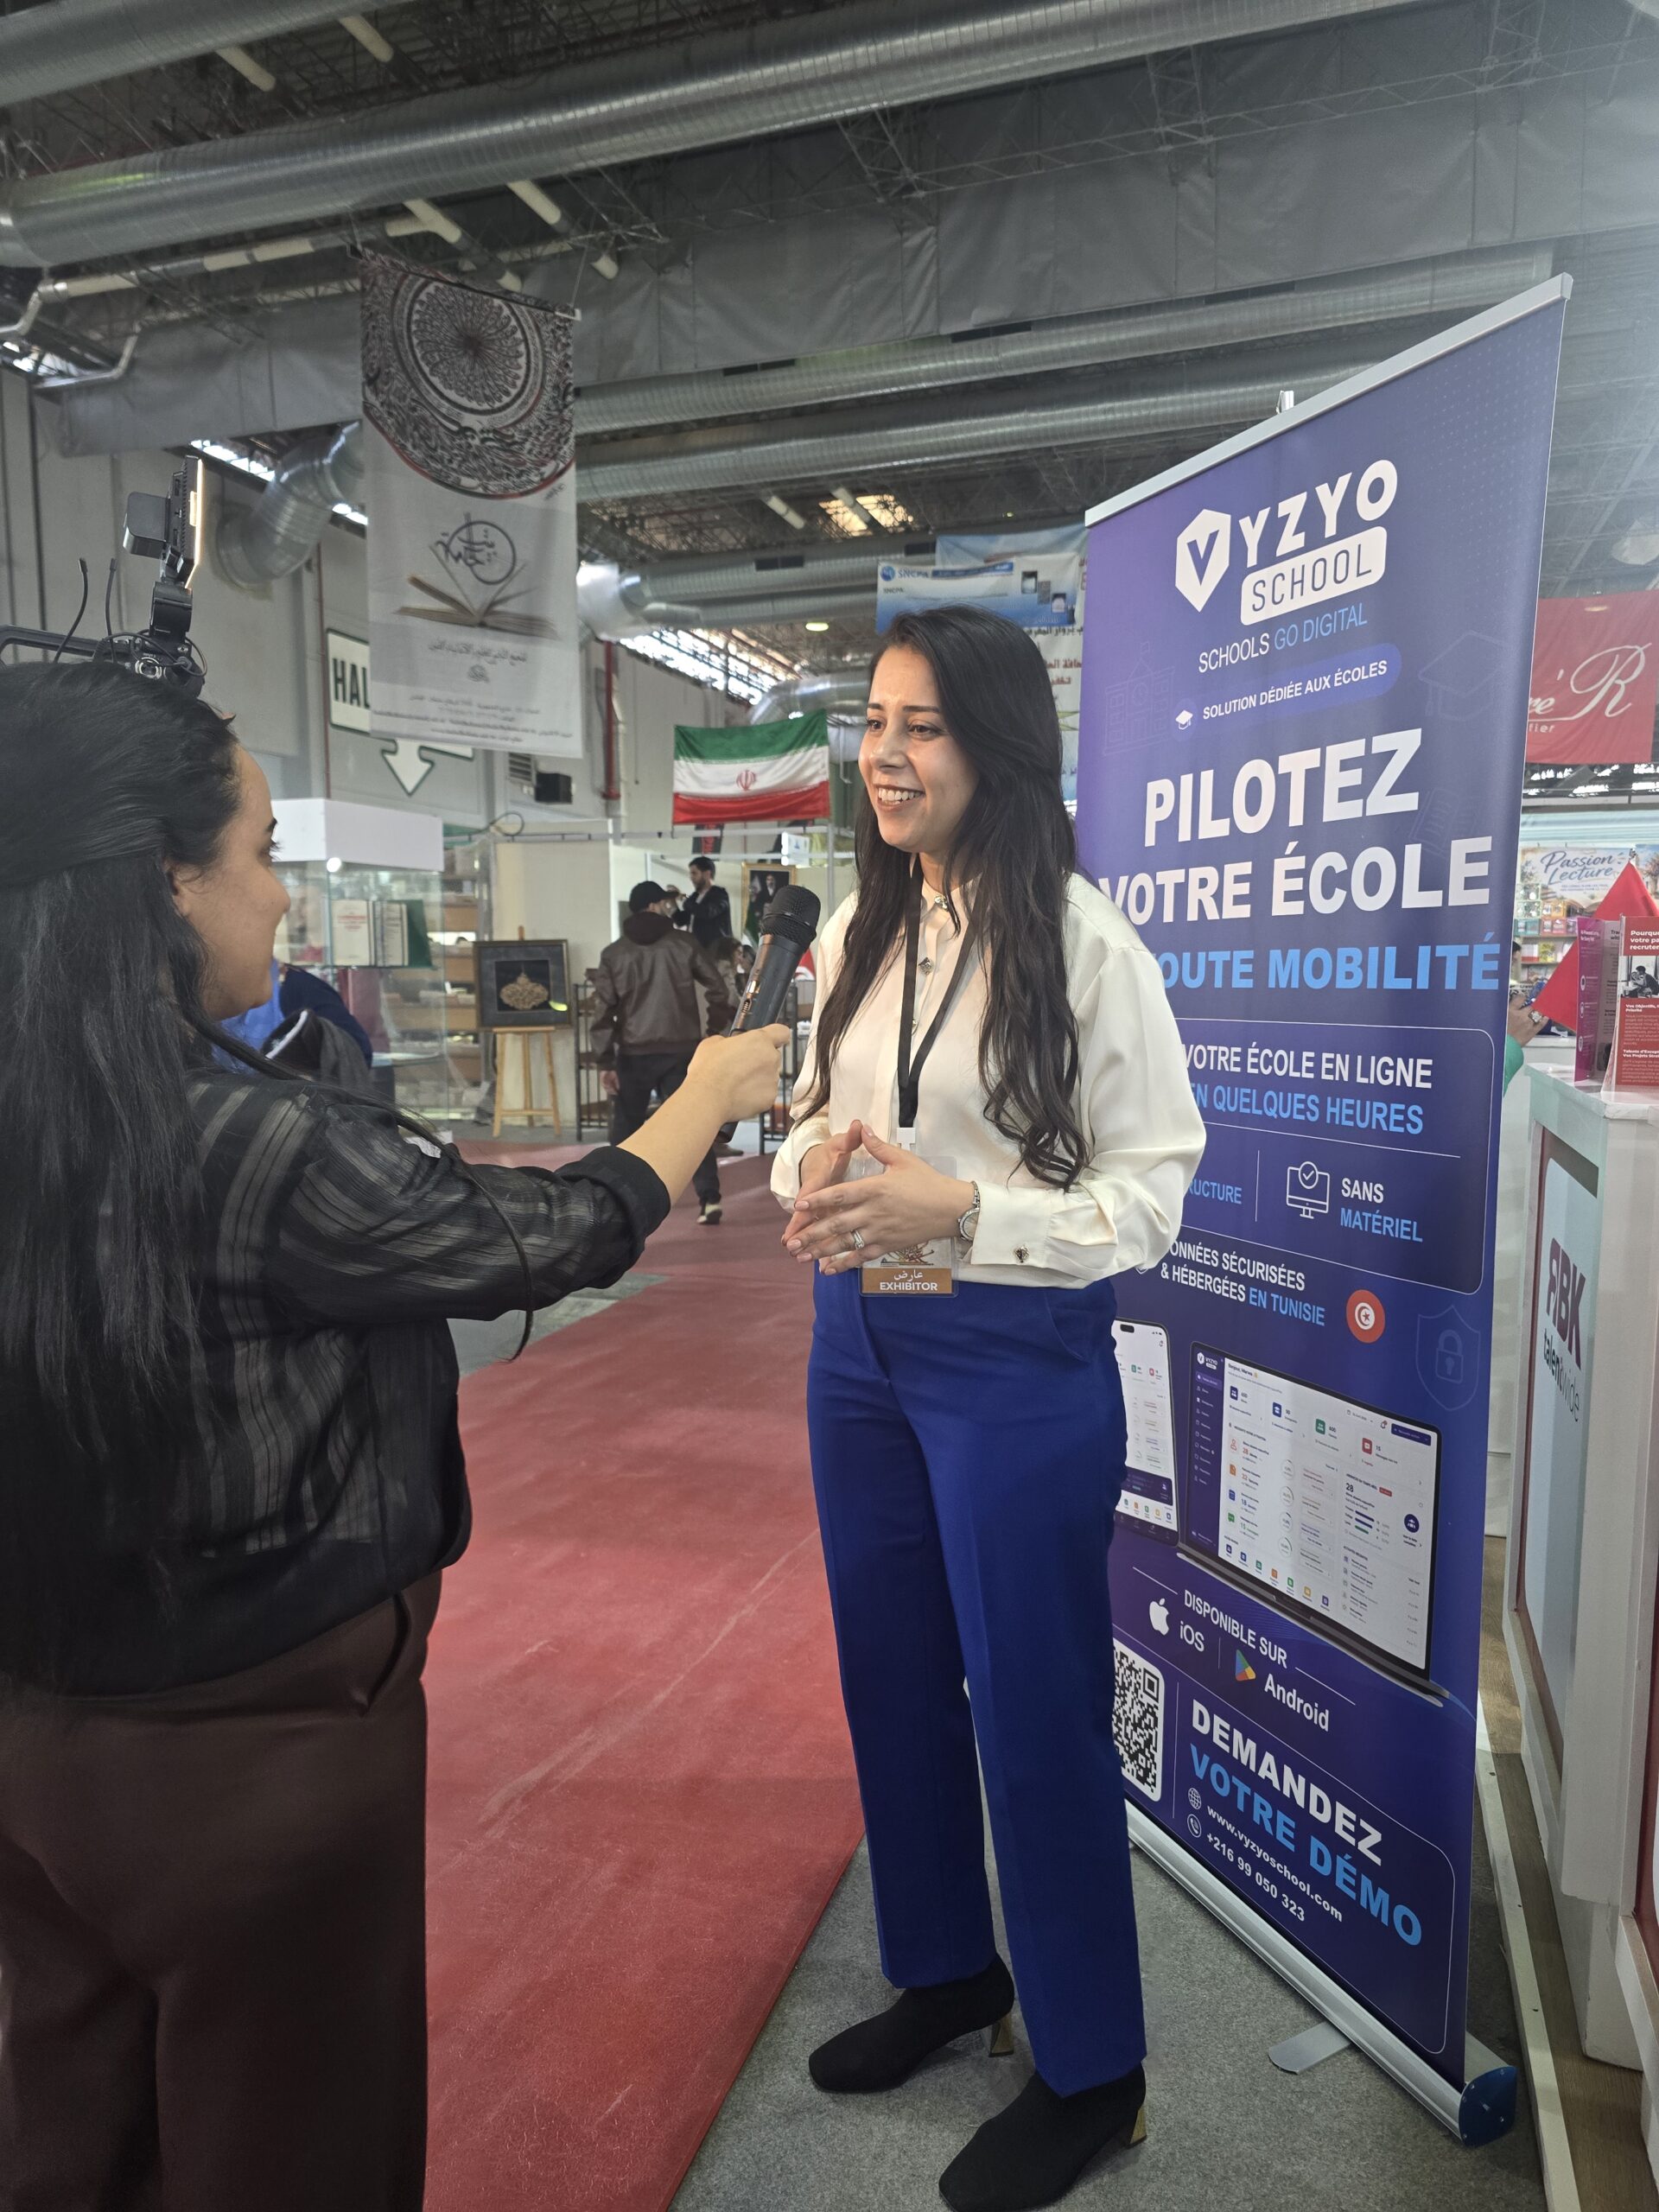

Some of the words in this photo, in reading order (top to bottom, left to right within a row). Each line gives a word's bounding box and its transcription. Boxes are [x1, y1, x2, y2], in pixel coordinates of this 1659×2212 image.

[1252, 543, 1372, 612] SCHOOL
[1198, 632, 1269, 673] SCHOOLS
[1274, 624, 1298, 651] GO
[1303, 602, 1368, 643] DIGITAL
[1203, 696, 1256, 721] SOLUTION
[1259, 680, 1302, 705] DÉDIÉE
[1305, 675, 1331, 694] AUX
[1334, 659, 1388, 687] ÉCOLES
[1144, 728, 1421, 847] PILOTEZ
[1098, 861, 1252, 925] VOTRE
[1271, 836, 1492, 917] ÉCOLE
[1541, 851, 1613, 873] Passion
[1548, 867, 1612, 885] Lecture
[1154, 950, 1253, 988] OUTE
[1268, 932, 1500, 990] MOBILITÉ
[1183, 1044, 1242, 1072] VOTRE
[1247, 1042, 1315, 1079] ÉCOLE
[1321, 1053, 1350, 1083] EN
[1357, 1056, 1433, 1089] LIGNE
[1213, 1085, 1320, 1123] QUELQUES
[1325, 1096, 1424, 1135] HEURES
[1341, 1178, 1384, 1205] SANS
[1340, 1208, 1423, 1243] MATÉRIEL
[880, 1281, 938, 1291] EXHIBITOR
[893, 1269, 924, 1282] عارض
[1160, 1262, 1169, 1280] &
[1172, 1262, 1246, 1303] HÉBERGÉES
[1249, 1288, 1268, 1309] EN
[1270, 1293, 1325, 1326] TUNISIE
[1169, 1239, 1219, 1267] ONNÉES
[1222, 1252, 1306, 1291] SÉCURISÉES
[1179, 1621, 1205, 1652] iOS
[1185, 1590, 1256, 1649] DISPONIBLE
[1259, 1637, 1287, 1669] SUR
[1264, 1673, 1329, 1732] Android
[1192, 1700, 1382, 1866] DEMANDEZ
[1190, 1744, 1296, 1853] VOTRE
[1309, 1835, 1422, 1946] DÉMO
[1207, 1805, 1343, 1922] www.vyzyoschool.com
[1207, 1832, 1235, 1863] +216
[1237, 1853, 1252, 1878] 99
[1255, 1870, 1277, 1899] 050
[1281, 1893, 1305, 1923] 323
